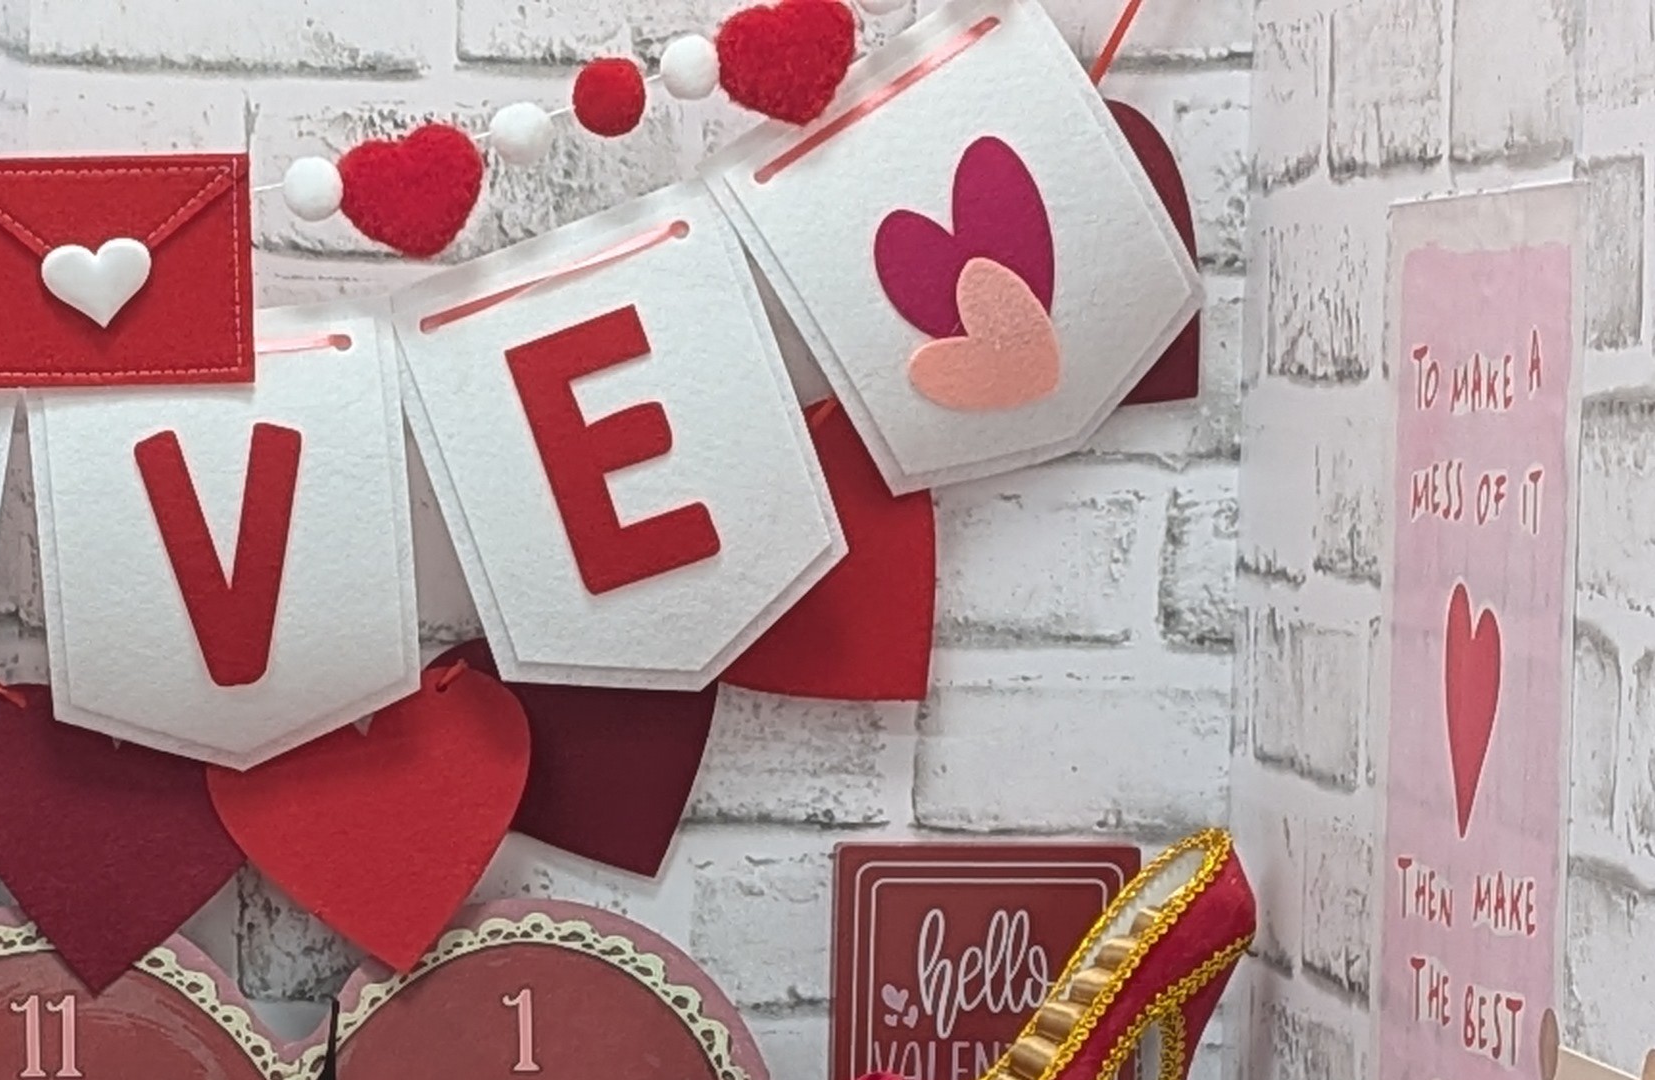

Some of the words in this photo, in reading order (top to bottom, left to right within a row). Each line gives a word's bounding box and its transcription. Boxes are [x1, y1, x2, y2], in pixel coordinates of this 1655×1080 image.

[1413, 345, 1440, 409] TO
[1450, 353, 1513, 413] MAKE
[1529, 329, 1542, 392] A
[1411, 460, 1463, 520] MESS
[1477, 474, 1507, 525] OF
[1521, 470, 1543, 534] IT
[1398, 857, 1454, 928] THEN
[1473, 870, 1536, 936] MAKE
[918, 908, 1059, 1039] hello
[1411, 957, 1450, 1026] THE
[1464, 985, 1524, 1067] BEST
[10, 995, 83, 1078] 11
[502, 989, 540, 1073] 1
